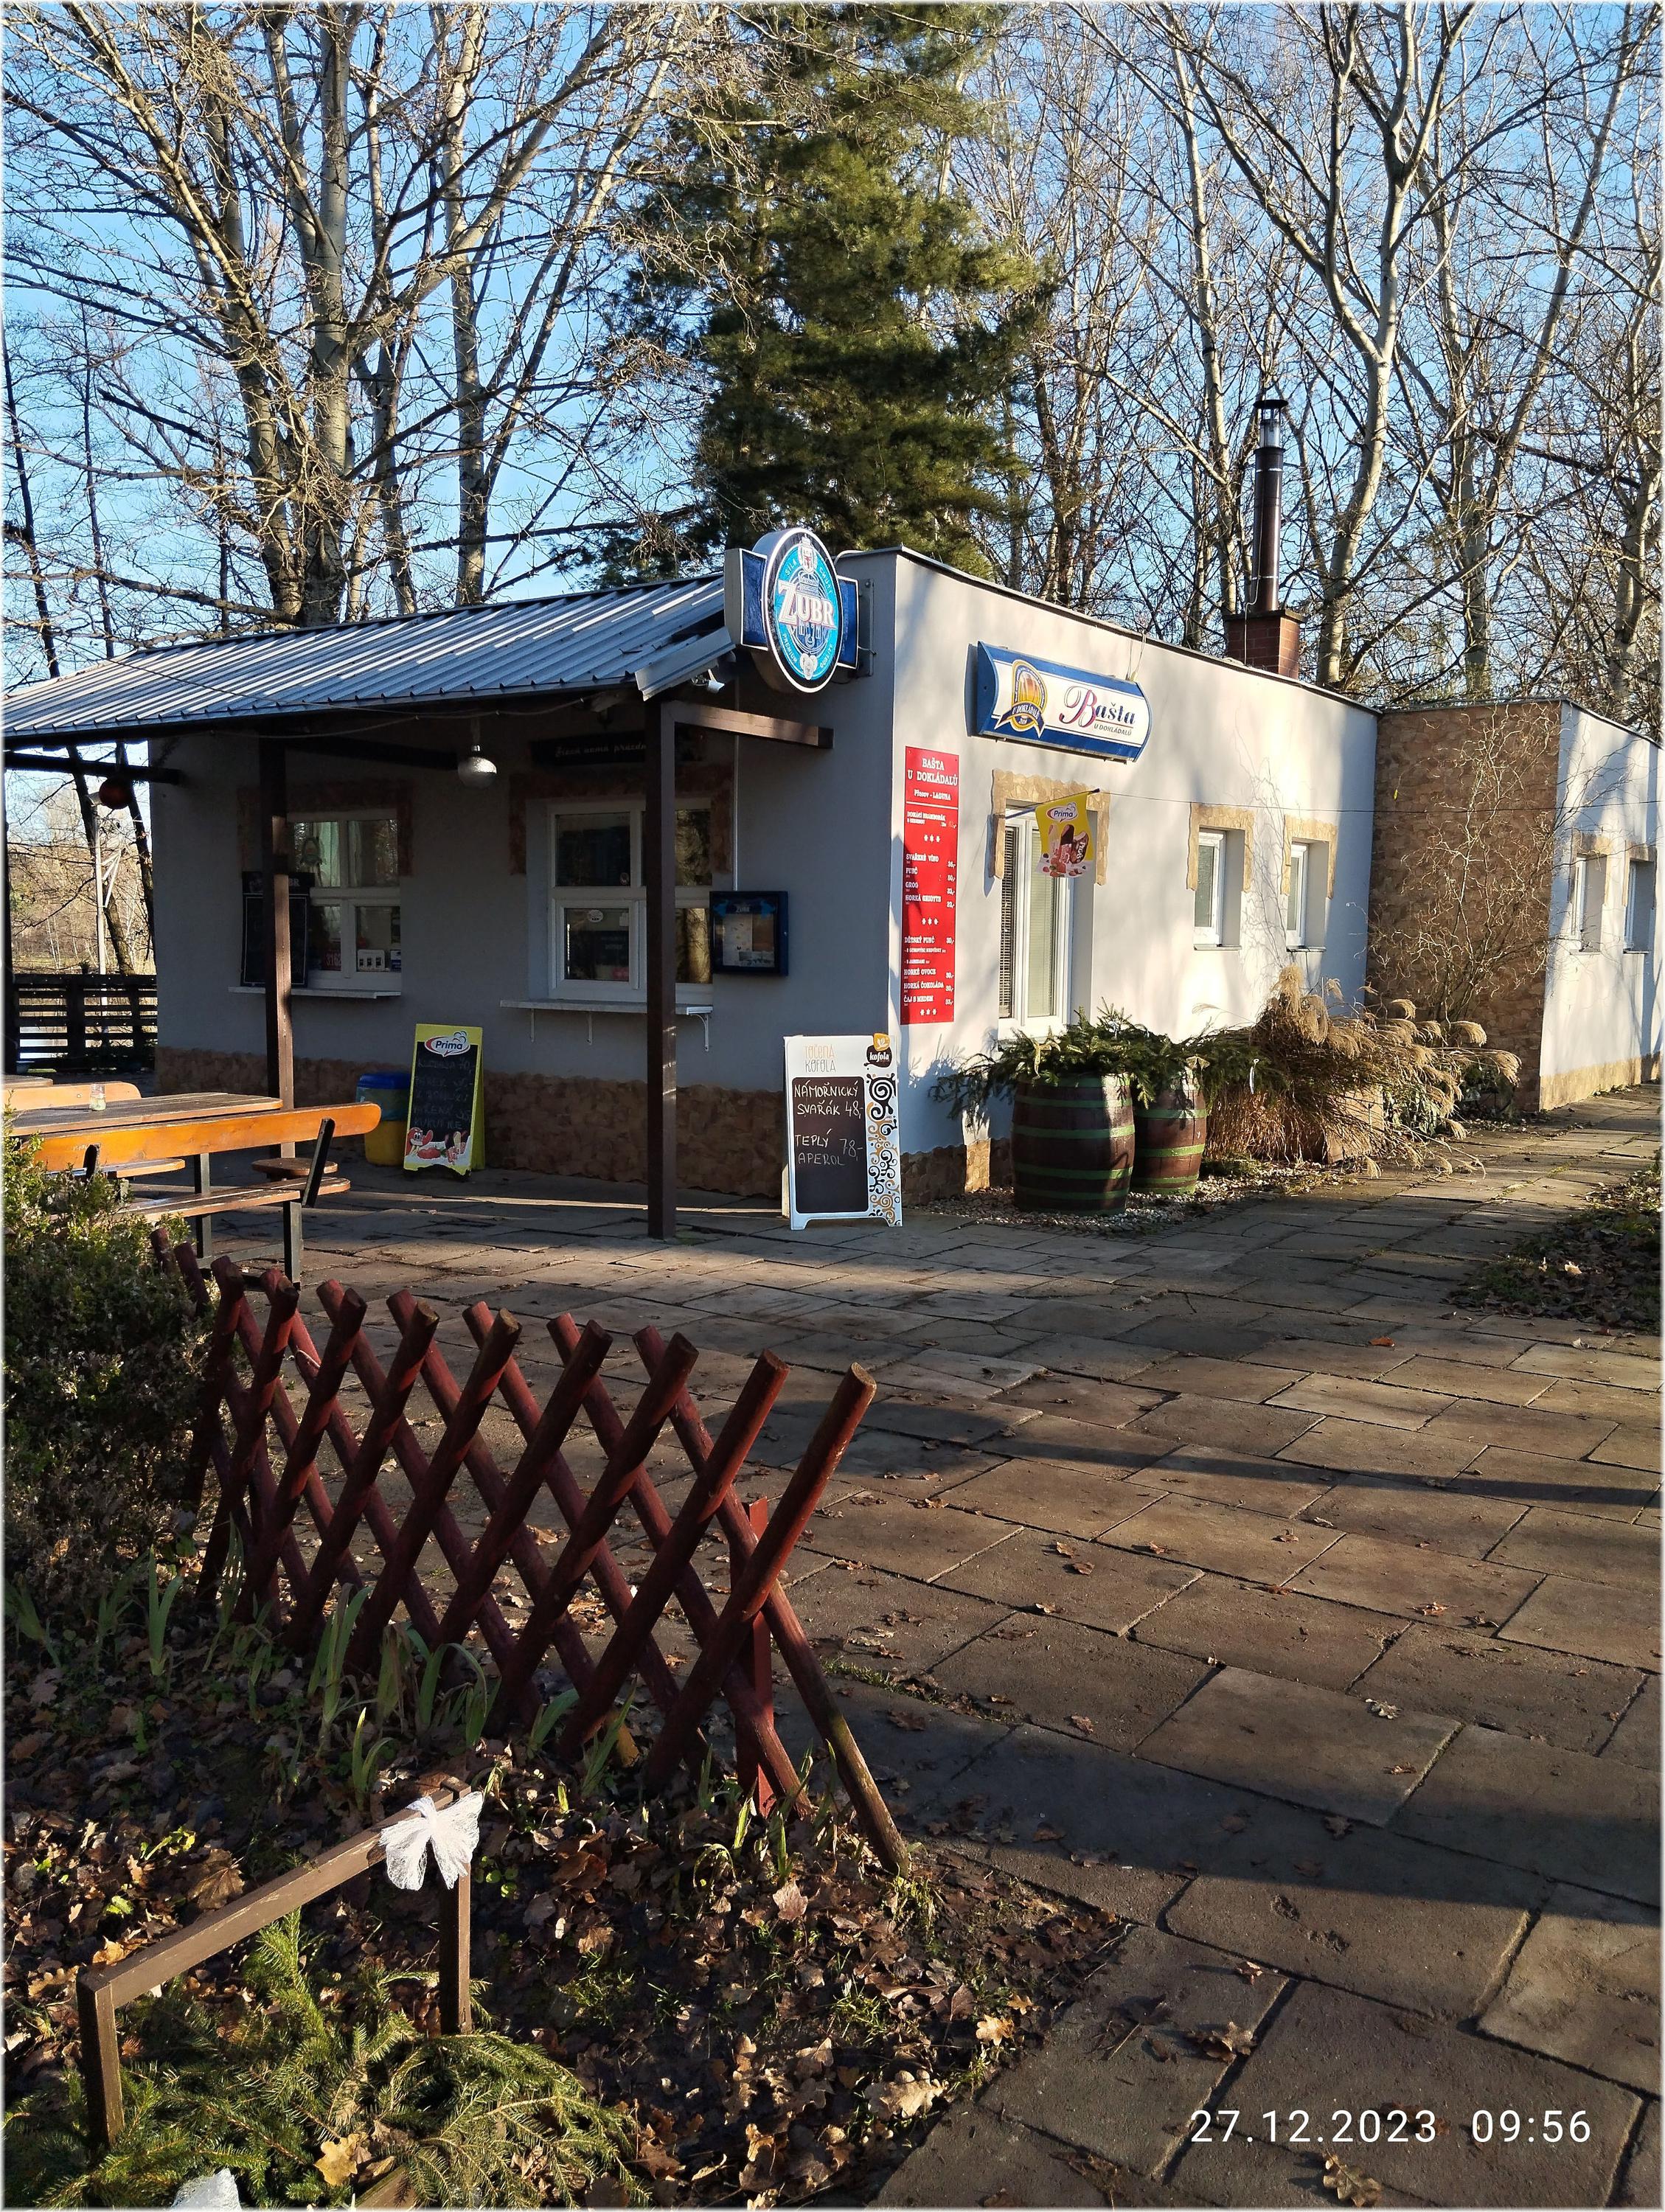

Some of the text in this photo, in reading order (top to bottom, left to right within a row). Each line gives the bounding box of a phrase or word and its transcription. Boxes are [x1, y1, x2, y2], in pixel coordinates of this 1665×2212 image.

[778, 579, 838, 630] ZUBR
[1059, 686, 1136, 728] Bašta
[1099, 723, 1132, 736] DOKLÁDALŮ
[922, 757, 945, 771] BAŠTA
[907, 770, 958, 786] U DOKLÁDALŮ
[435, 1040, 463, 1050] Prima
[869, 1051, 889, 1062] kofola
[804, 1060, 836, 1073] KOFOLA
[794, 1079, 858, 1098] NÁMOŘNICKÝ
[797, 1099, 841, 1116] SVAŘÁK
[795, 1129, 832, 1148] TEPLÝ
[798, 1152, 846, 1166] APEROL
